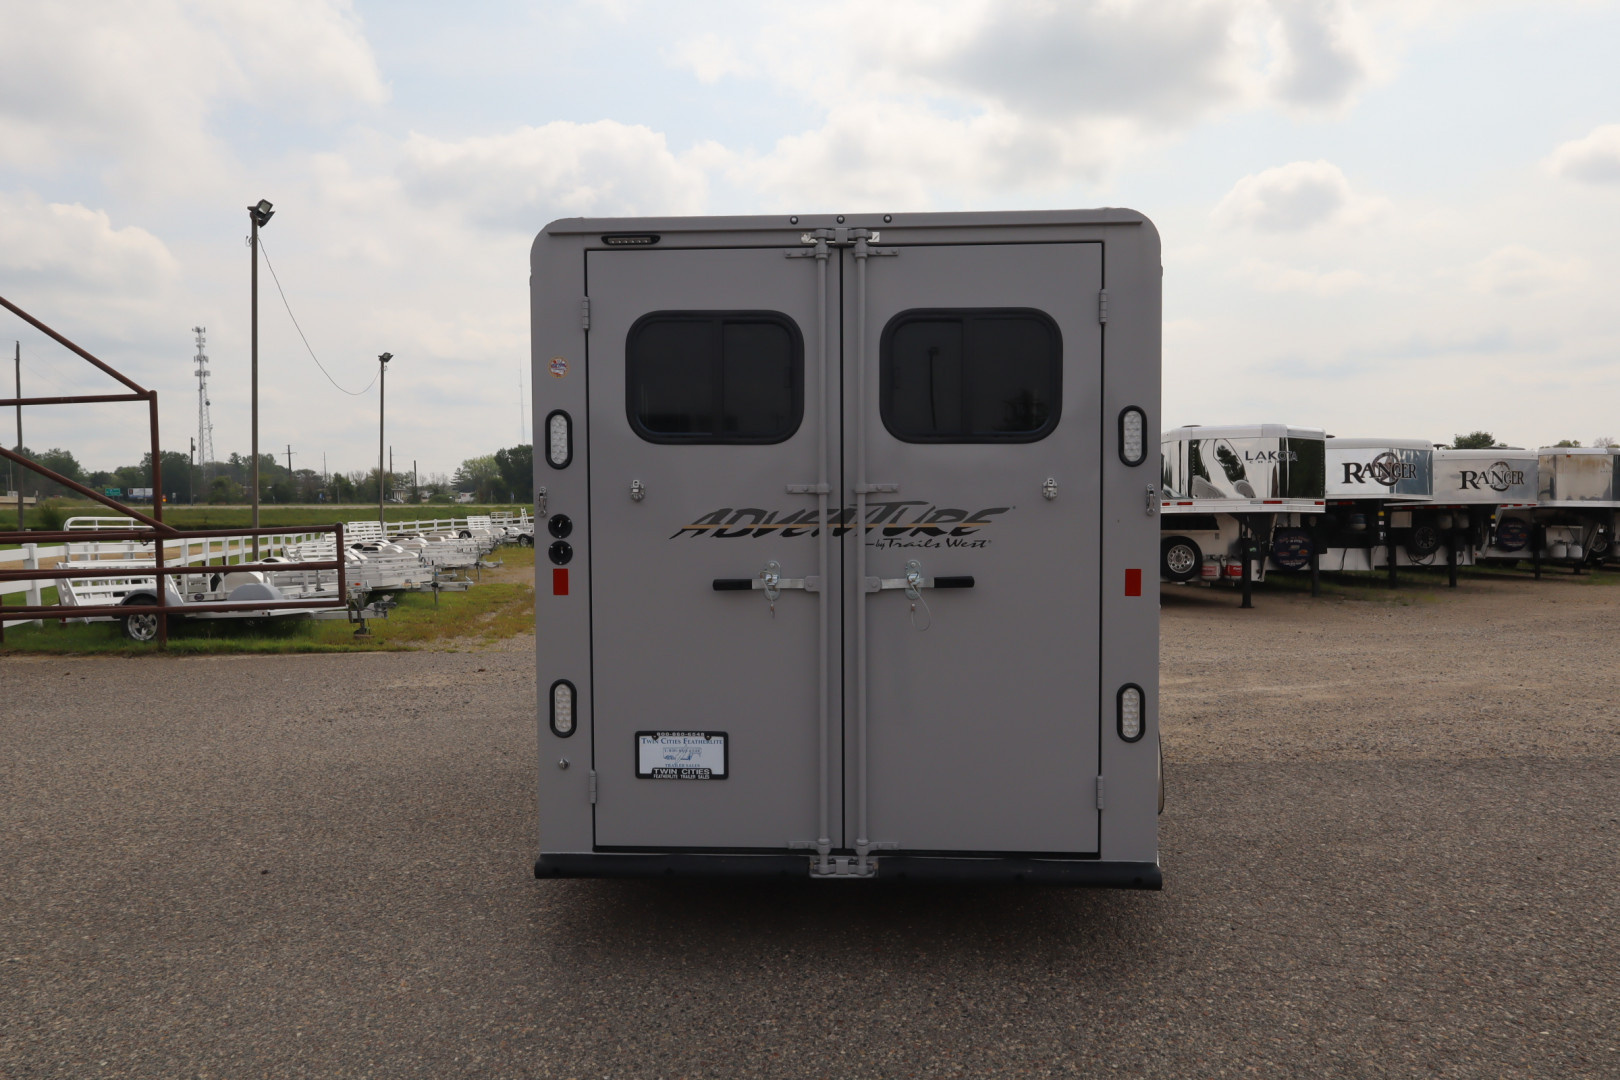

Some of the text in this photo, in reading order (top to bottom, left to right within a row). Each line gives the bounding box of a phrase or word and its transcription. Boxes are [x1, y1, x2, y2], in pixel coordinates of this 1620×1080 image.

[1245, 450, 1299, 462] LAKOTA
[1341, 462, 1417, 484] RANGER
[1458, 470, 1524, 490] RANGER
[669, 500, 1010, 540] ADVENTURE
[883, 537, 941, 549] Trails
